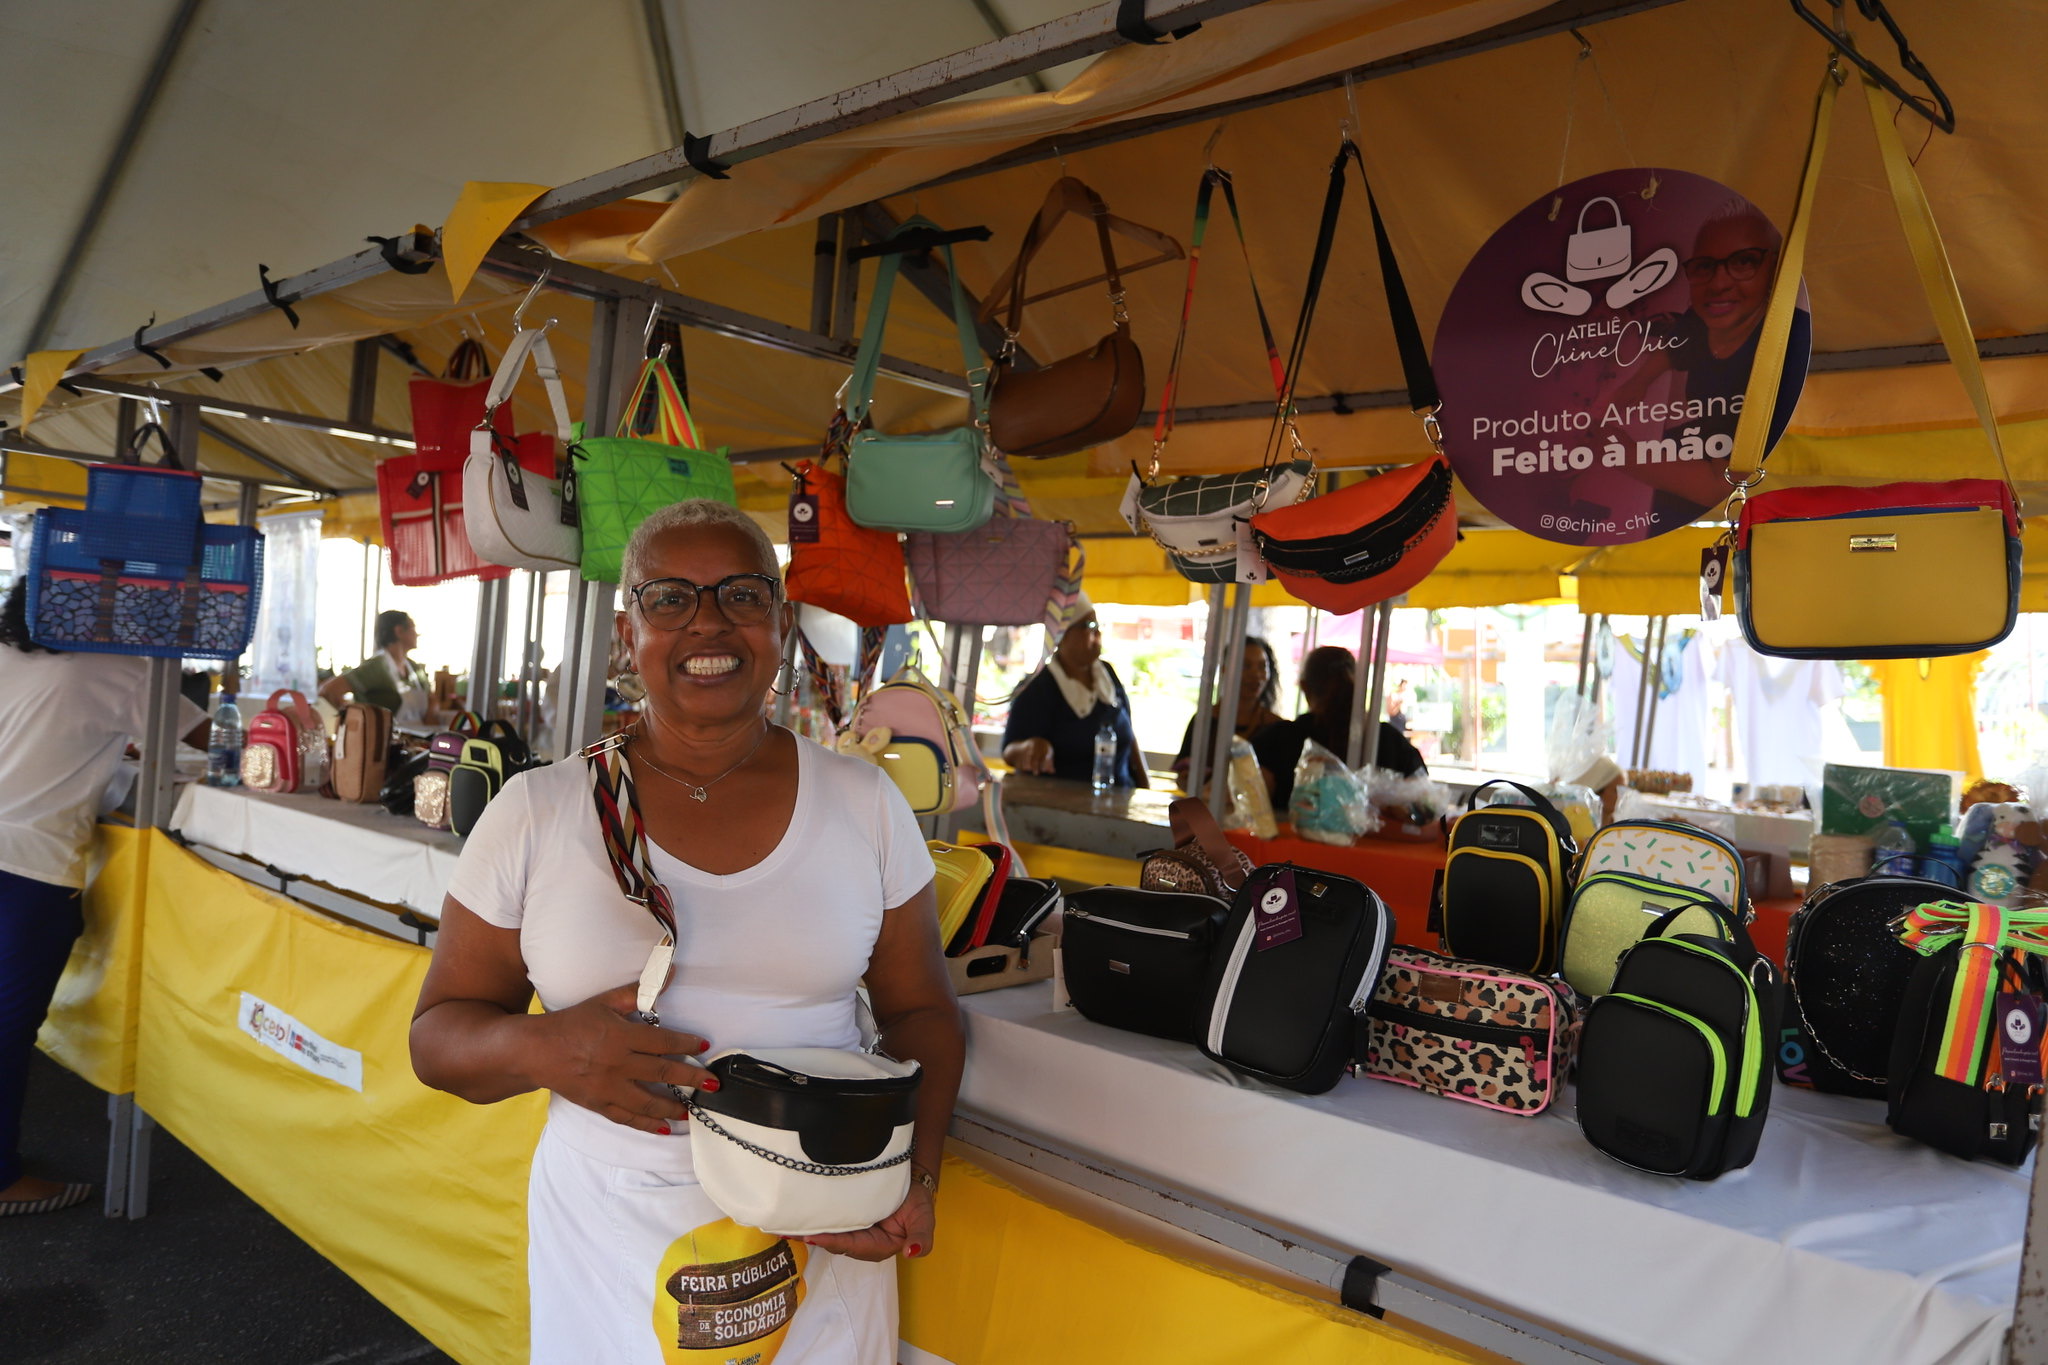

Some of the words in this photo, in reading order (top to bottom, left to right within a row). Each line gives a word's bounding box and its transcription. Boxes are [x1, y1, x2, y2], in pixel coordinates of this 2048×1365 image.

[1531, 332, 1616, 378] Chine
[1615, 320, 1689, 367] Chic
[1567, 316, 1621, 341] ATELIÊ
[1473, 410, 1591, 440] Produto
[1600, 394, 1746, 428] Artesana
[1492, 439, 1594, 477] Feito
[1601, 435, 1626, 467] à
[1636, 426, 1734, 465] mão
[1555, 511, 1660, 536] @chine_chic
[1780, 1027, 1813, 1088] LOV
[681, 1274, 728, 1292] FEIRA
[731, 1251, 788, 1288] PÚBLICA
[714, 1291, 786, 1325] ECONOMIA
[714, 1307, 787, 1341] SOLIDÁRIA
